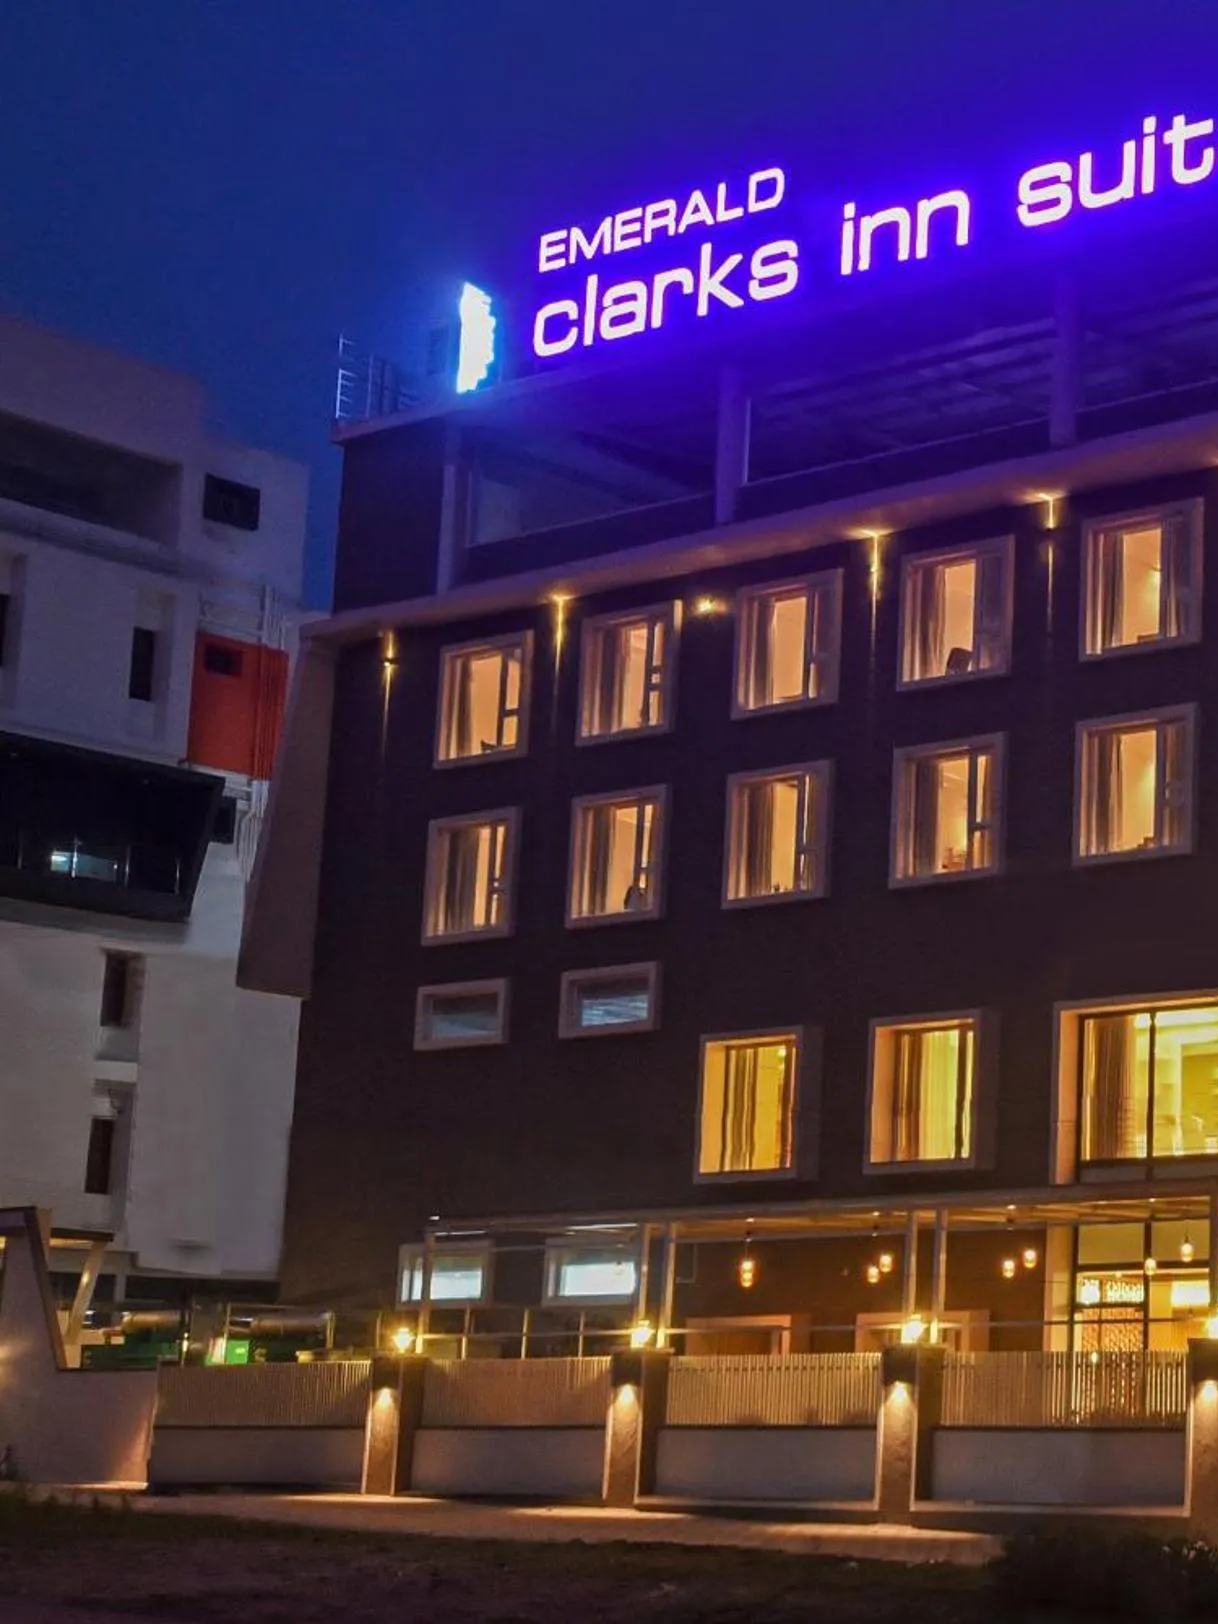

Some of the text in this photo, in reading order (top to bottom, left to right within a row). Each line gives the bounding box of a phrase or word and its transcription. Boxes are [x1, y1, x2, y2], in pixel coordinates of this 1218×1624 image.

[532, 239, 799, 358] clarks
[840, 189, 971, 276] inn
[538, 167, 786, 273] EMERALD
